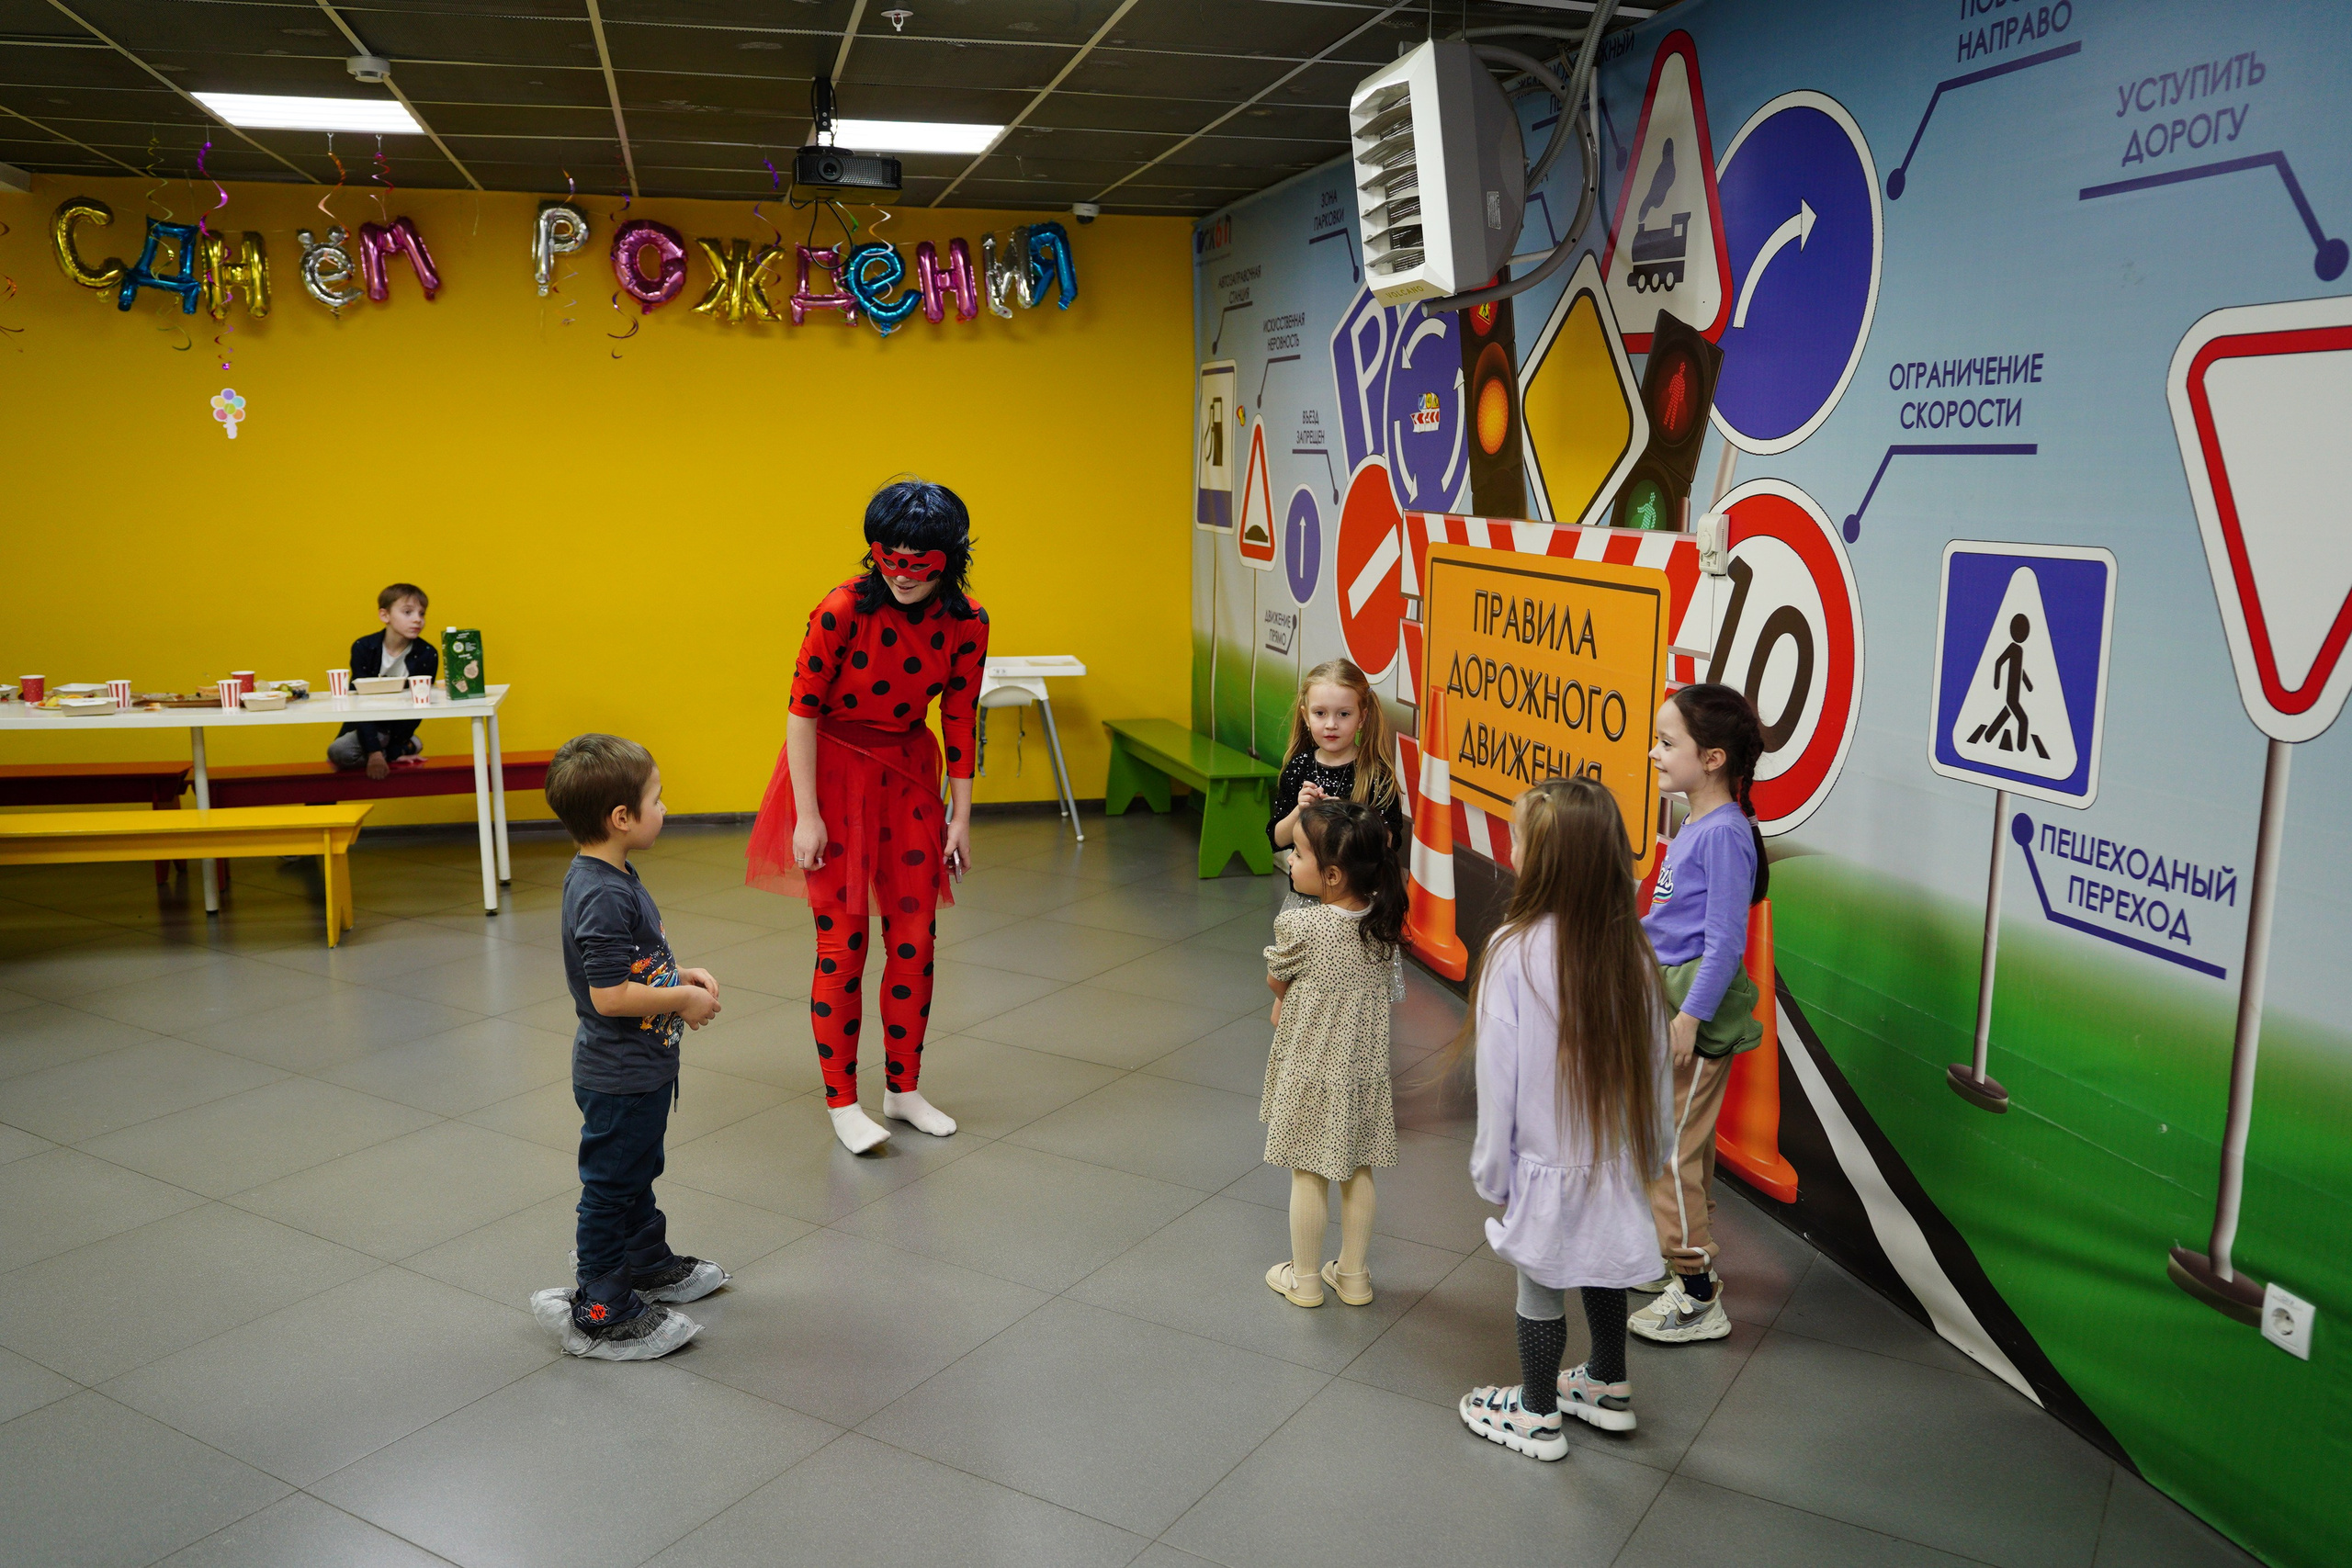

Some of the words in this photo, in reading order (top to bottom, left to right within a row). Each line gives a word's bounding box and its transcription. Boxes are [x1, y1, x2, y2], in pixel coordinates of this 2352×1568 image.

[1958, 0, 2072, 62] НАПРАВО
[2116, 51, 2267, 118] УСТУПИТЬ
[2121, 104, 2249, 167] ДОРОГУ
[1313, 210, 1345, 231] ПАРКОВКИ
[1320, 189, 1338, 208] ЗОНА
[1385, 286, 1424, 299] VOLCANO
[1267, 333, 1300, 352] НЕРОВНОСТЬ
[1889, 353, 2044, 391] ОГРАНИЧЕНИЕ
[1900, 398, 2022, 429] СКОРОСТИ
[1264, 610, 1291, 628] ДВИЖЕНИЕ
[1270, 628, 1286, 646] ПРЯМО
[1473, 589, 1597, 660] ПРАВИЛА
[1706, 555, 1815, 753] 10
[1447, 650, 1627, 742] ДОРОЖНОГО
[2040, 823, 2238, 907] ПЕШЕХОДНЫЙ
[2067, 874, 2192, 946] ПЕРЕХОД
